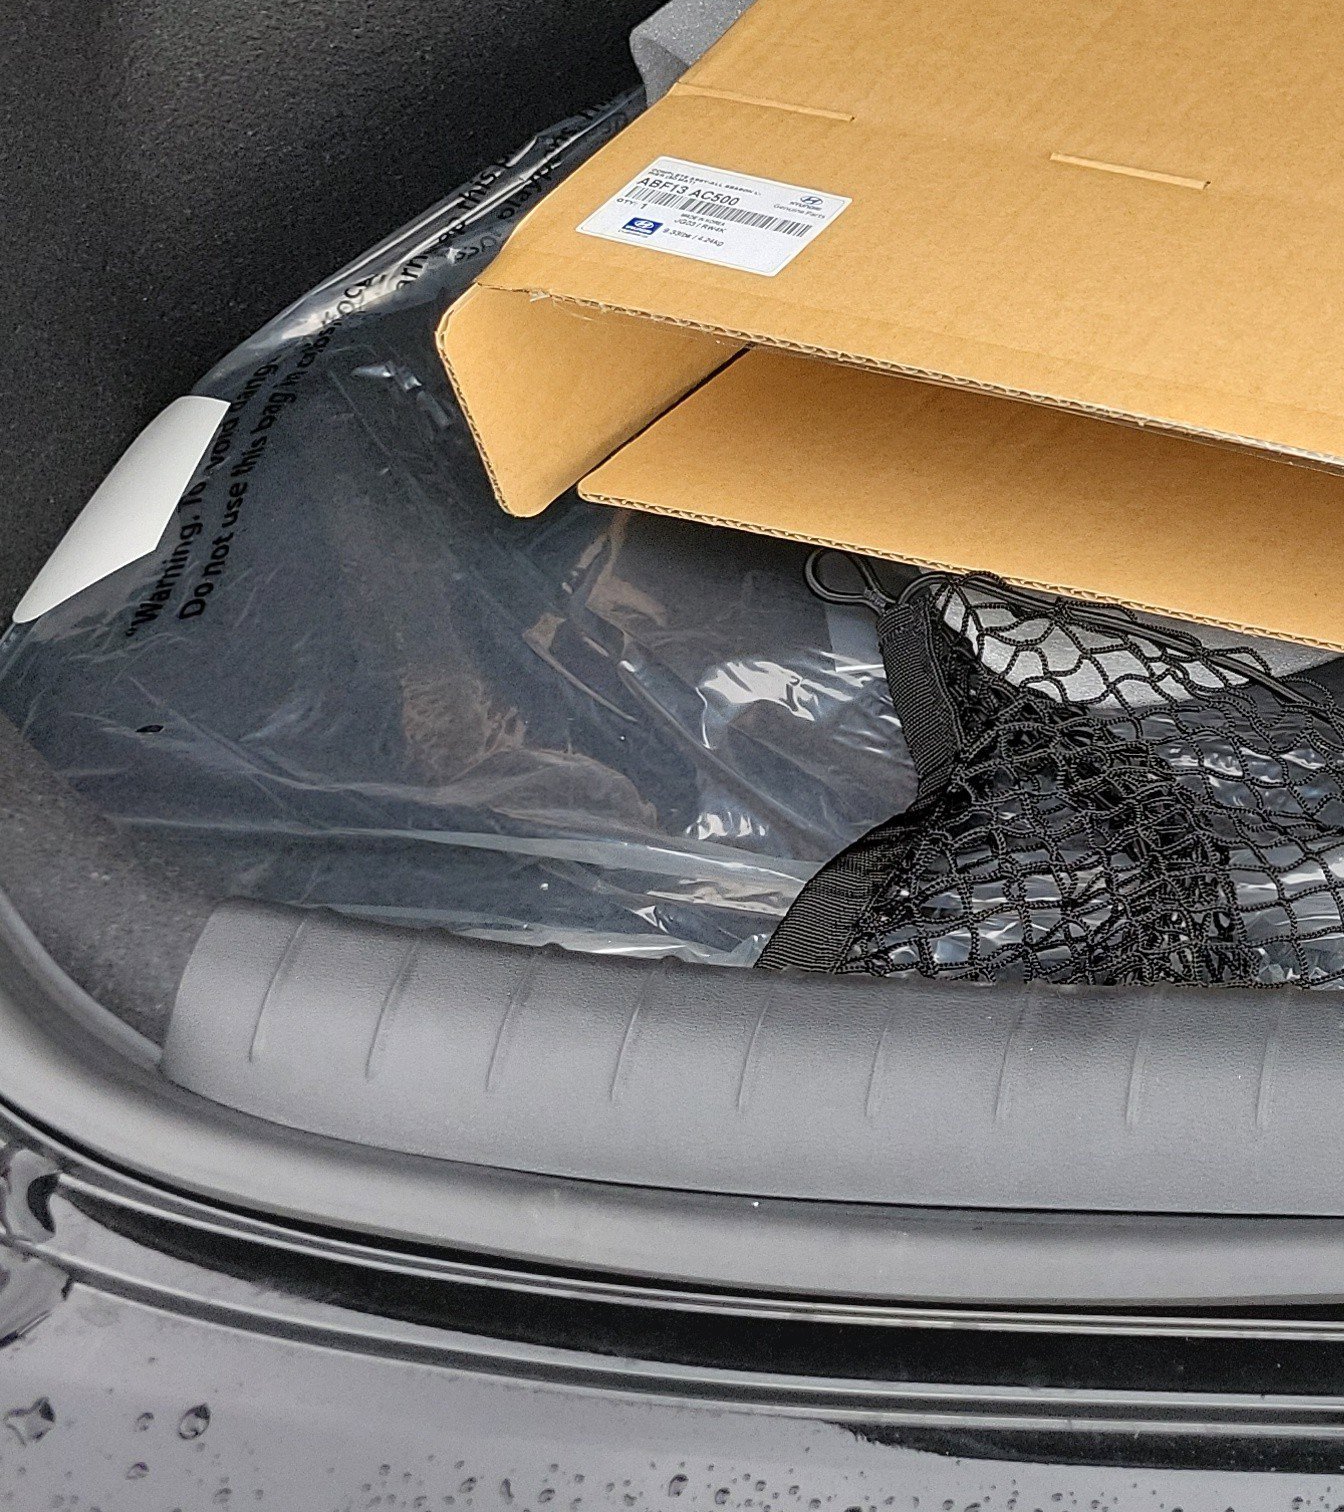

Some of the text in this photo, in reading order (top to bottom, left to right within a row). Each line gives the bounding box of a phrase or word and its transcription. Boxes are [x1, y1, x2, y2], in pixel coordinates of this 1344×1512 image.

[636, 176, 690, 194] ABF13
[687, 187, 742, 206] AC500
[803, 210, 827, 219] Parts
[250, 392, 298, 434] bag
[230, 436, 269, 477] this
[221, 481, 248, 528] use
[202, 532, 235, 576] not
[177, 582, 214, 620] Do
